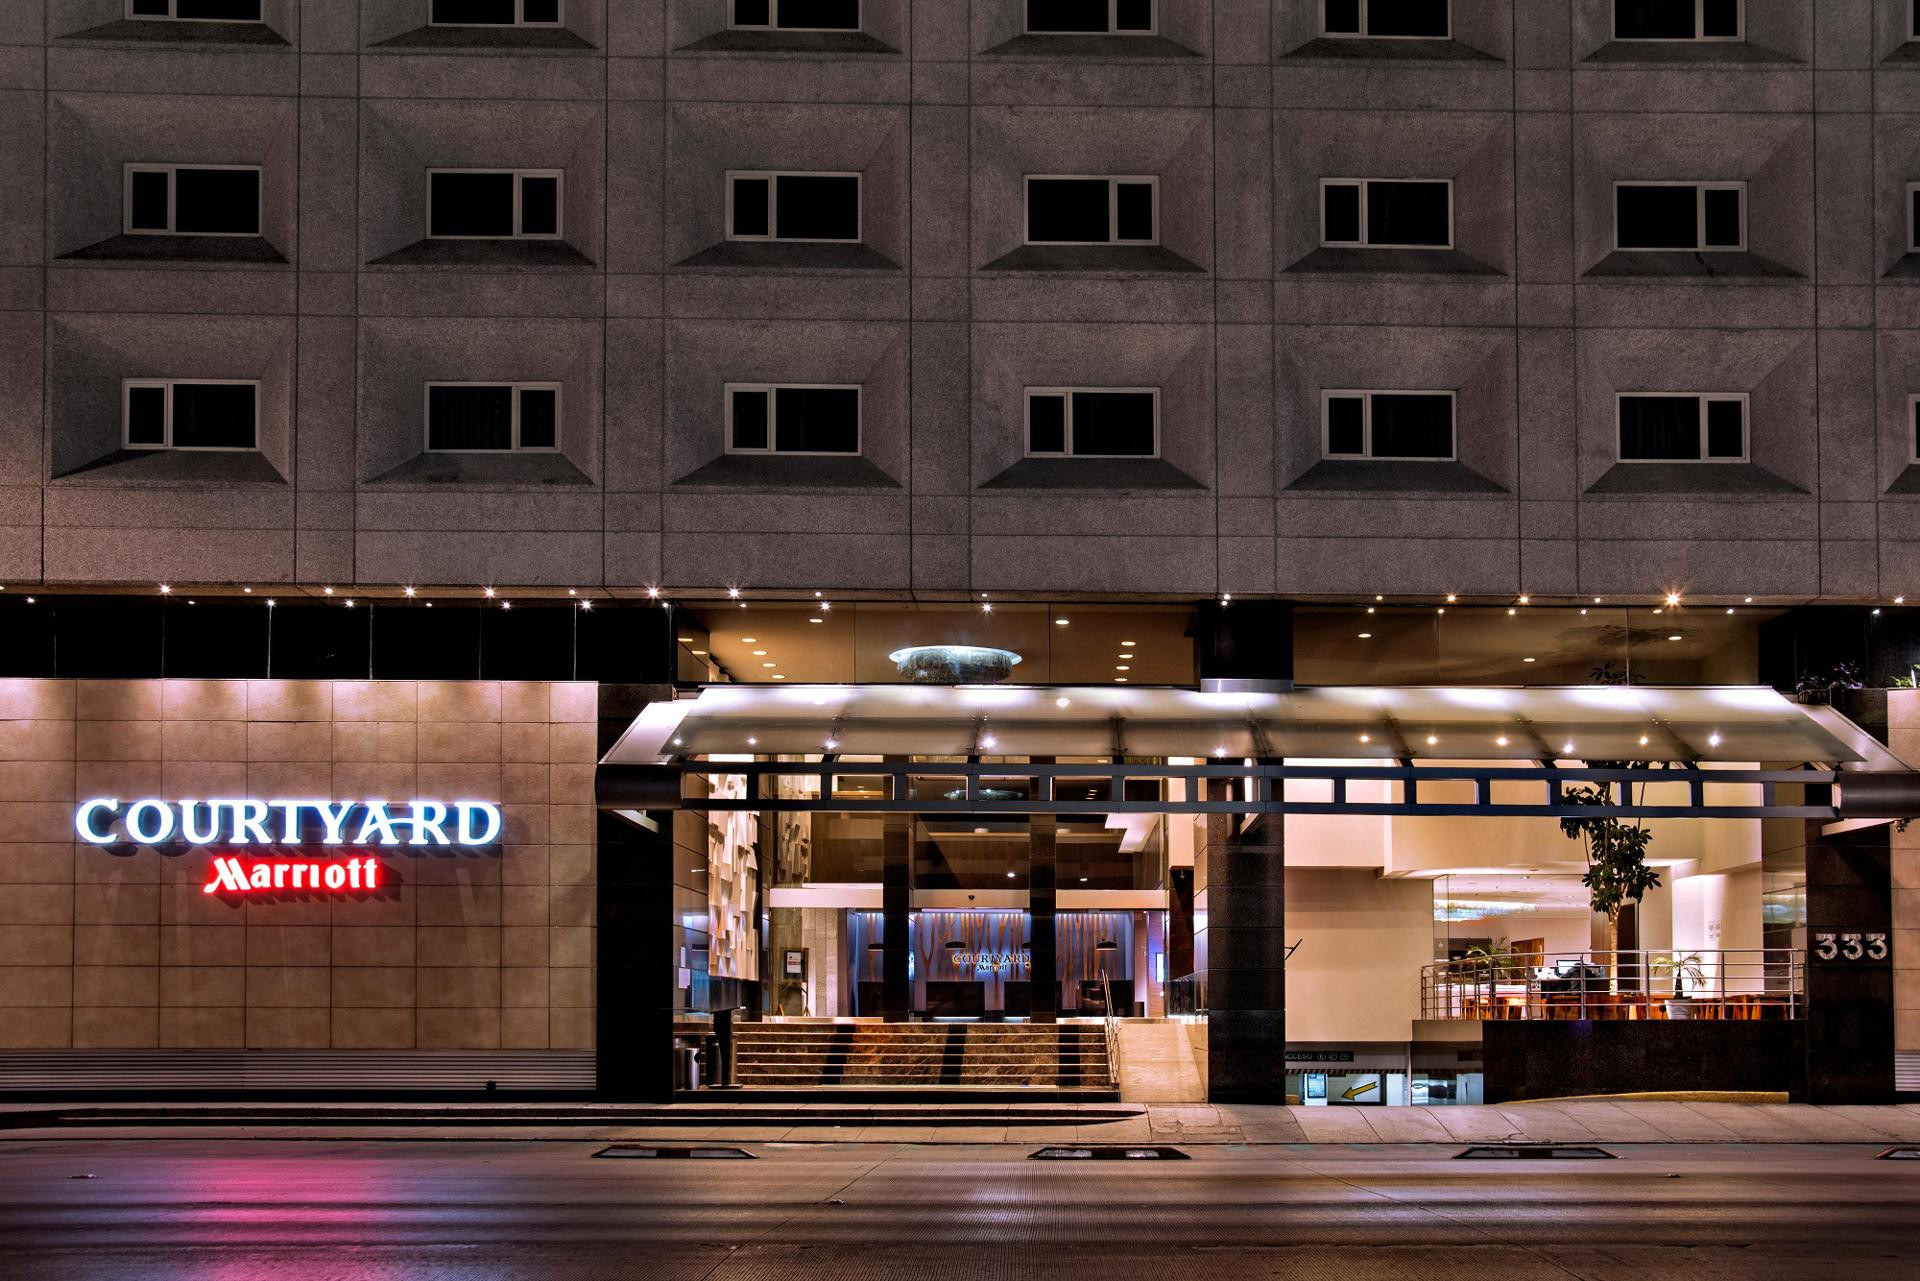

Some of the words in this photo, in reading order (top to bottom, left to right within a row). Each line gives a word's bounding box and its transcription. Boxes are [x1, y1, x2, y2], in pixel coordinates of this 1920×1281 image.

[75, 798, 501, 845] COURTYARD
[204, 857, 377, 893] Marriott
[953, 953, 1031, 963] COURTYARD
[1815, 933, 1887, 959] 333
